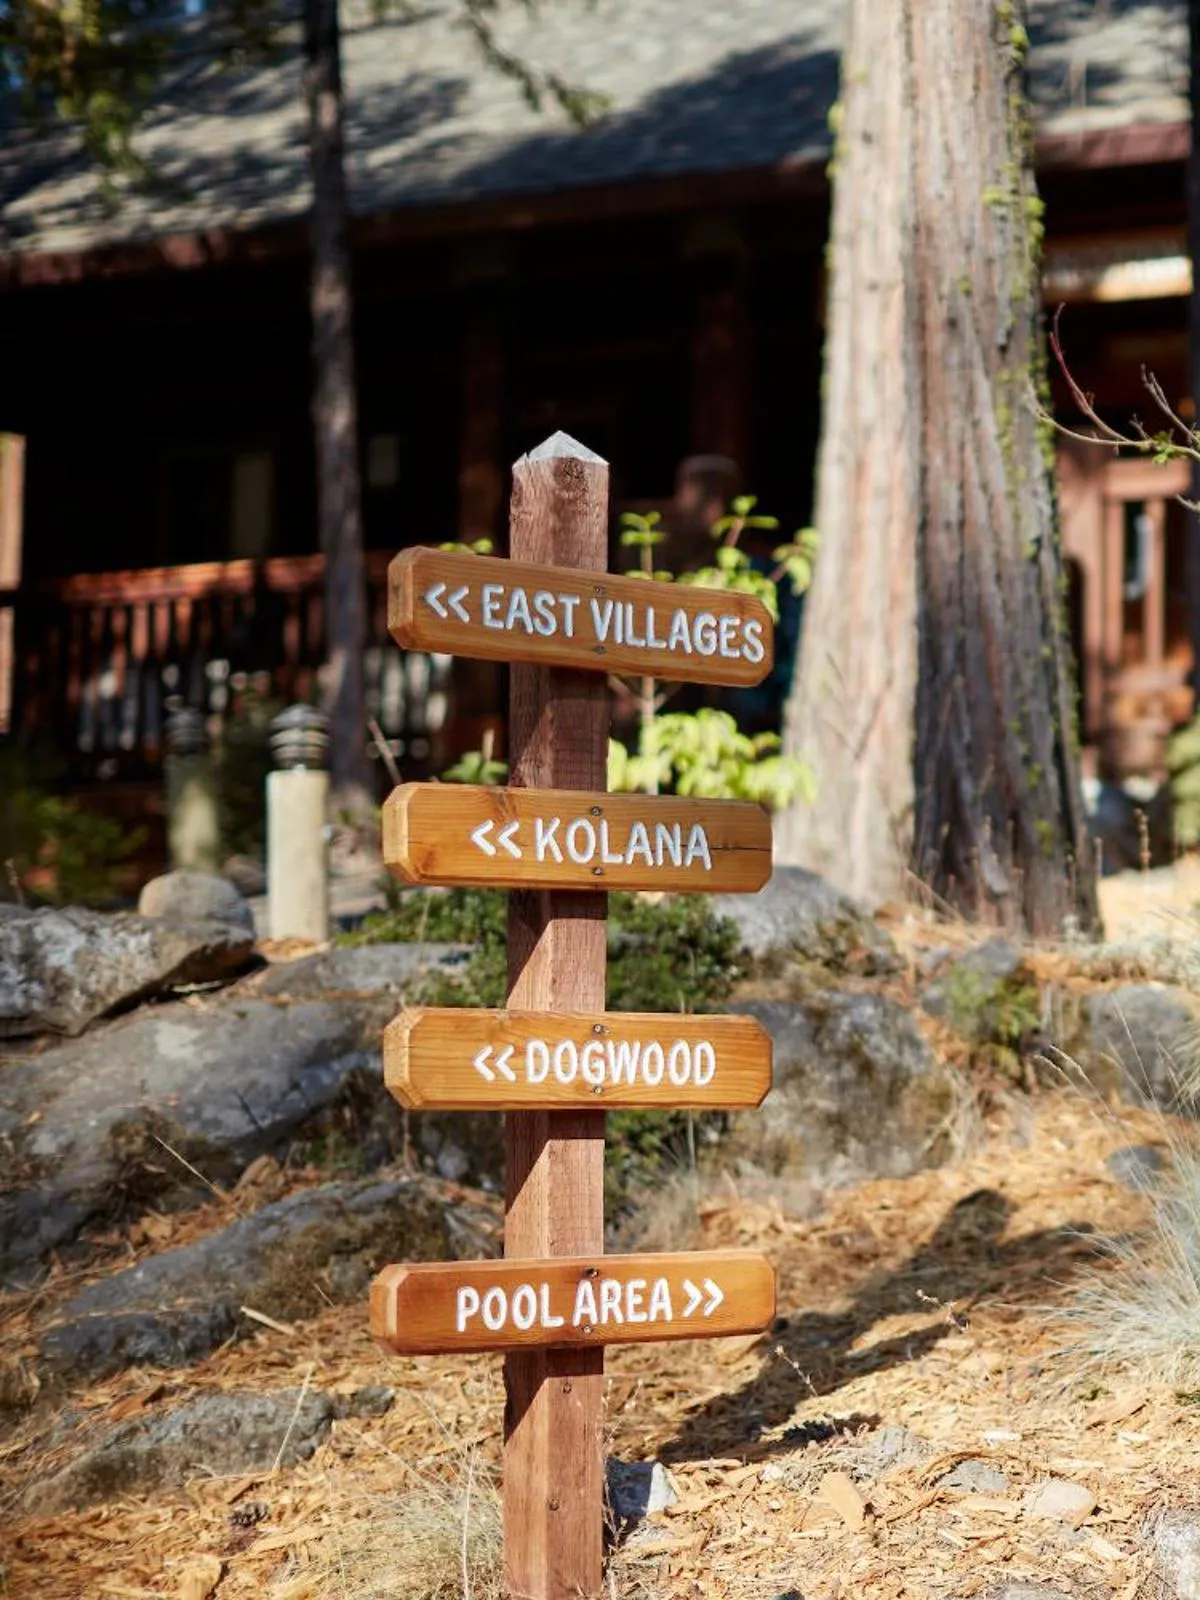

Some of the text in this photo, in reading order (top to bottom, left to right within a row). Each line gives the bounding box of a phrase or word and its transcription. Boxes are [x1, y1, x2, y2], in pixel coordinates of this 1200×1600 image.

[481, 583, 765, 664] EAST VILLAGES
[534, 817, 713, 871] KOLANA
[524, 1038, 717, 1086] DOGWOOD
[455, 1277, 673, 1333] POOL AREA
